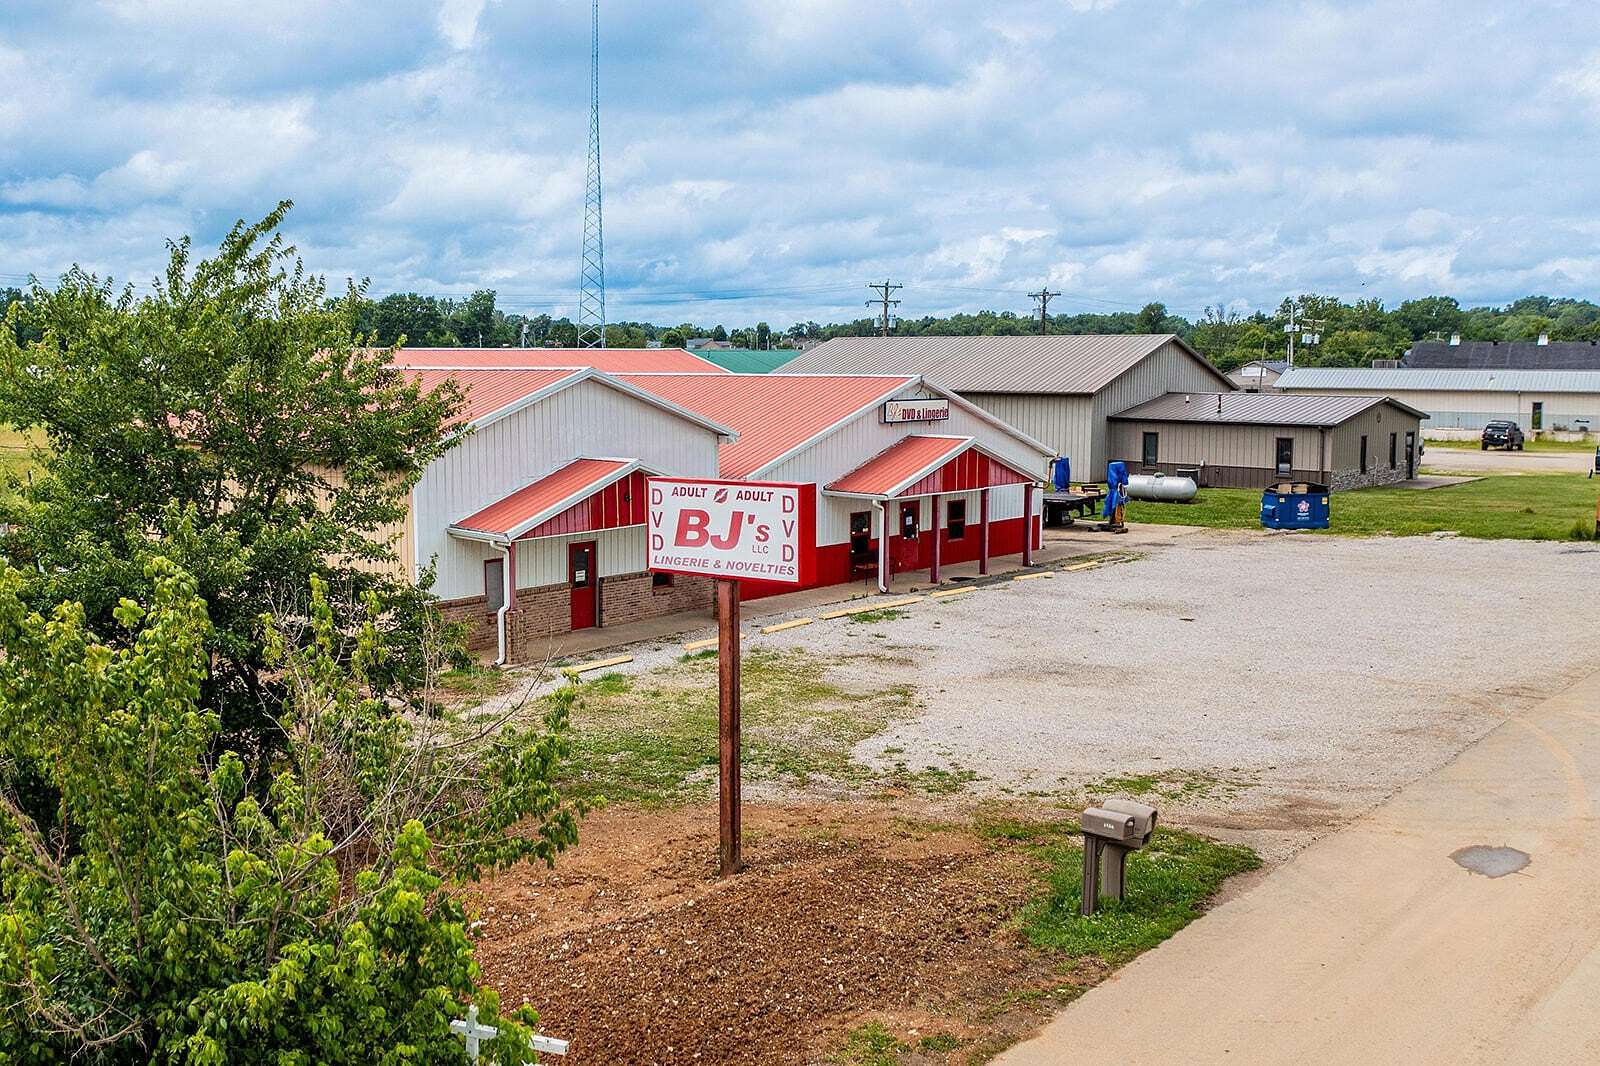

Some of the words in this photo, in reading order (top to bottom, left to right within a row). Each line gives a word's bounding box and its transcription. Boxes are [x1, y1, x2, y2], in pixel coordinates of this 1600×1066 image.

[902, 408, 916, 420] DVD
[922, 407, 949, 420] Lingerie
[671, 486, 708, 498] ADULT
[735, 490, 774, 502] ADULT
[651, 488, 664, 551] DVD
[674, 508, 770, 550] BJ's
[782, 495, 795, 562] DVD
[752, 545, 769, 554] LLC
[654, 555, 709, 568] LINGERIE
[713, 559, 721, 569] &
[726, 560, 795, 576] NOVELTIES
